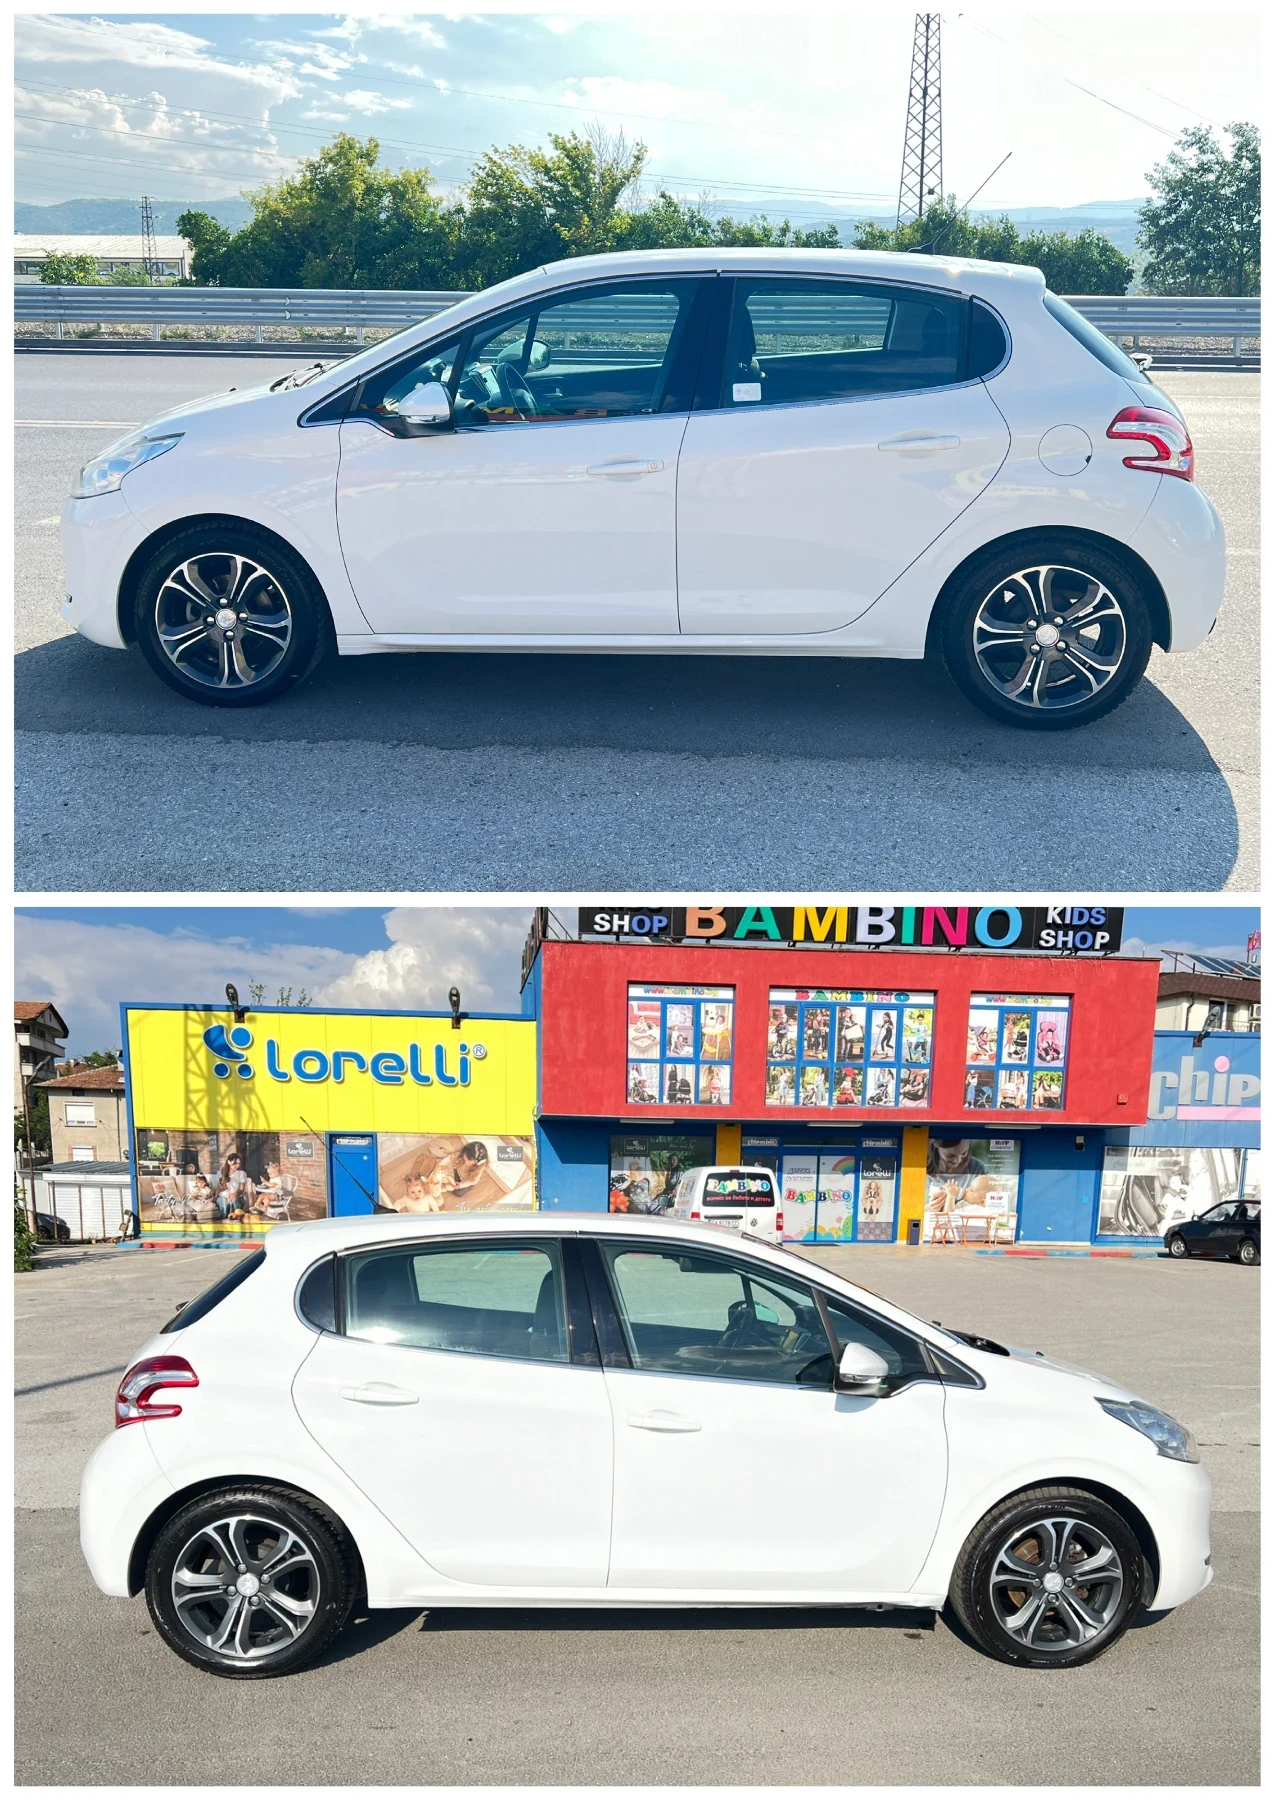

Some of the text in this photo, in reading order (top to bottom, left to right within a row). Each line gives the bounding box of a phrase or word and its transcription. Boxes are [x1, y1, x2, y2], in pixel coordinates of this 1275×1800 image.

[1076, 552, 1123, 584] KUMHO
[593, 914, 669, 934] SHOP
[1046, 907, 1106, 926] KIDS
[686, 907, 1023, 947] BAMBINO
[1039, 930, 1110, 950] SHOP
[795, 989, 911, 1003] BAMBINO
[706, 1179, 770, 1194] BAMBINO
[785, 1188, 852, 1204] BAMBINO
